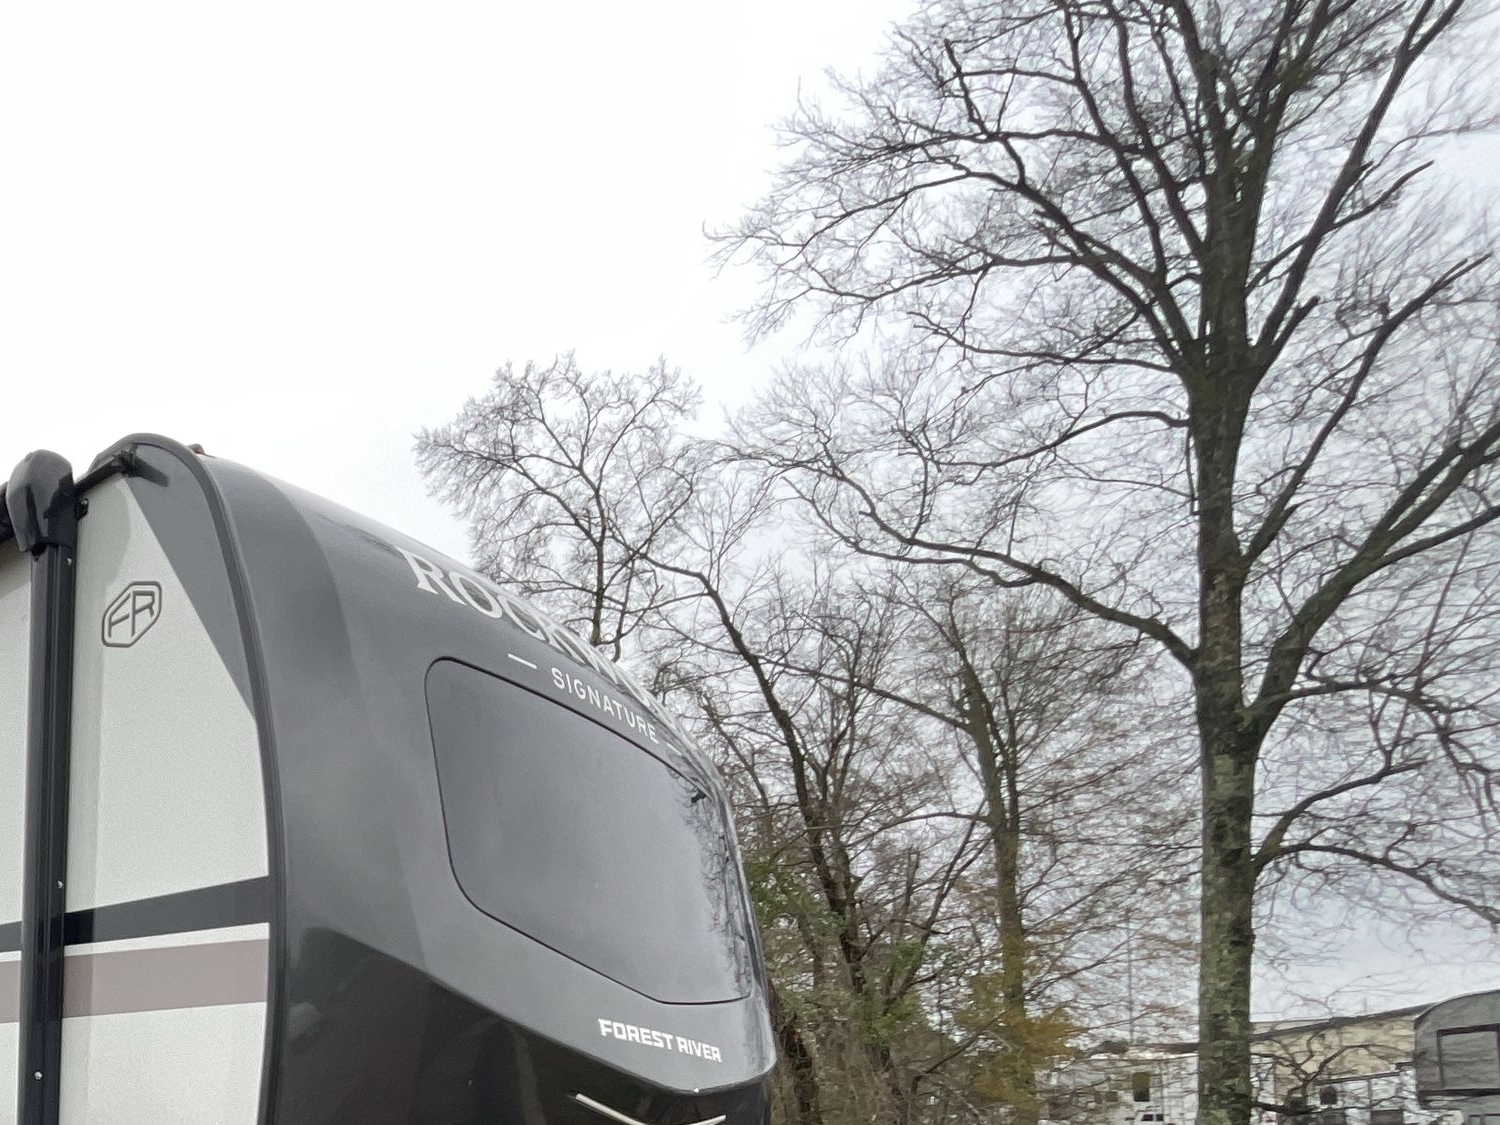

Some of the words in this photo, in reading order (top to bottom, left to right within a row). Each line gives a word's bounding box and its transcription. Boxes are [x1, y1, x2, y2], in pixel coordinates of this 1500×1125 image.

[396, 546, 704, 757] ROCKW
[551, 667, 659, 744] SIGNATURE
[598, 1018, 673, 1050] FOREST
[676, 1036, 723, 1063] RIVER
